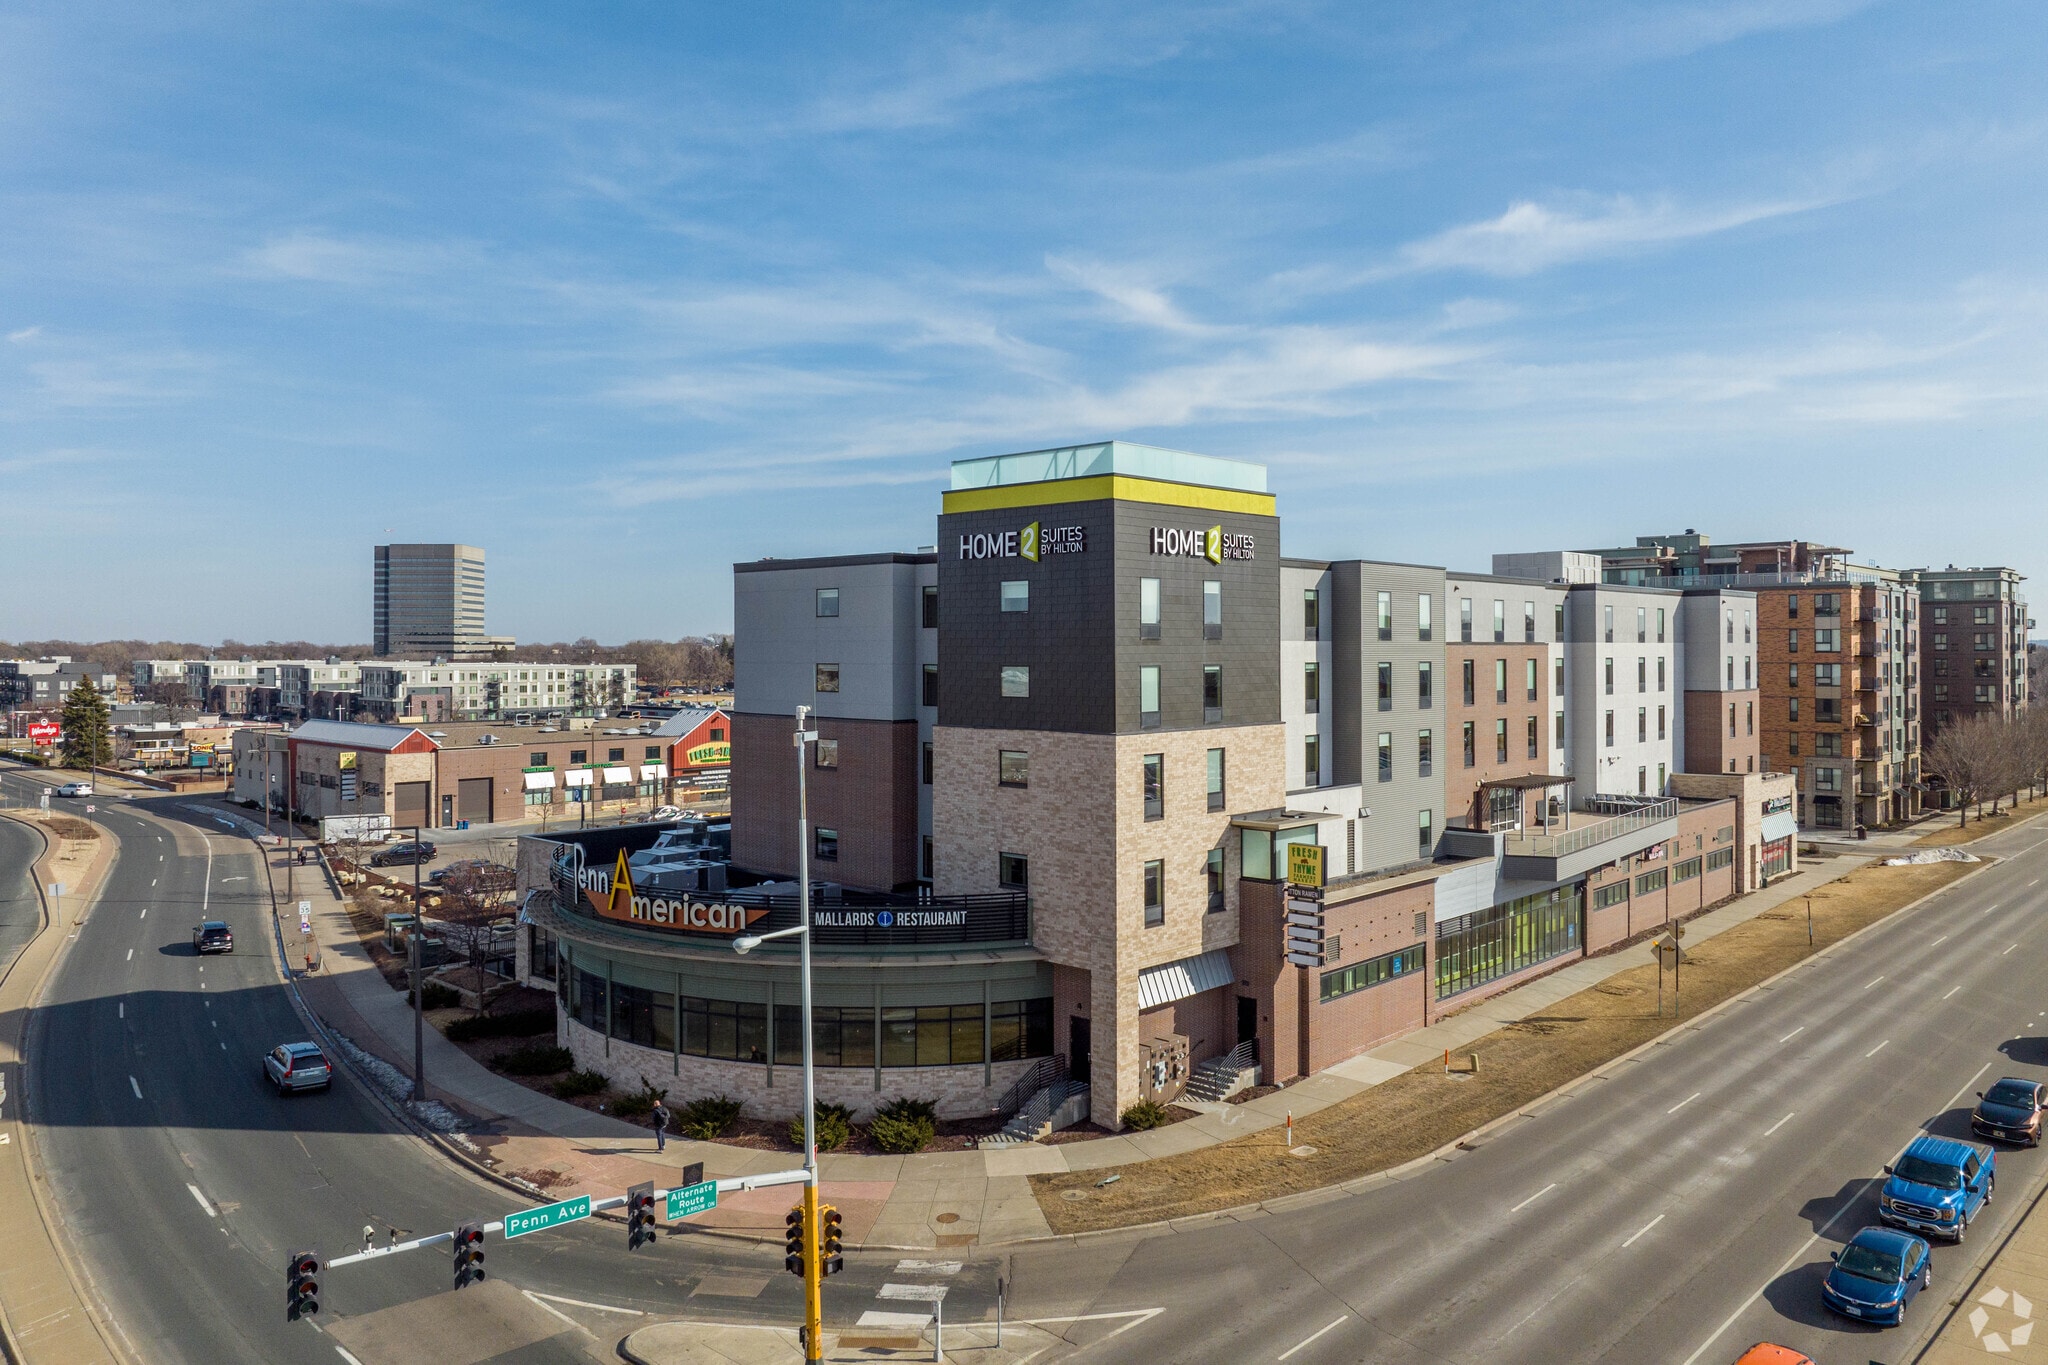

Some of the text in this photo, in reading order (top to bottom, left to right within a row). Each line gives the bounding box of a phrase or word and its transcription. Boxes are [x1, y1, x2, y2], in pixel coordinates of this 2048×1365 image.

[960, 526, 1083, 559] HOME 2 SUITES
[1041, 542, 1083, 555] BY HILTON
[1154, 527, 1254, 559] HOME 2 SUITES
[1223, 548, 1254, 559] BY HILTON
[1292, 847, 1318, 860] FRESH
[1293, 863, 1316, 875] THYME
[574, 843, 746, 930] Penn American
[815, 911, 967, 926] MALLARDS RESTAURANT
[671, 1184, 713, 1202] Alternate
[679, 1196, 704, 1209] Route
[686, 1203, 705, 1214] ARROW
[511, 1203, 586, 1232] Penn Ave
